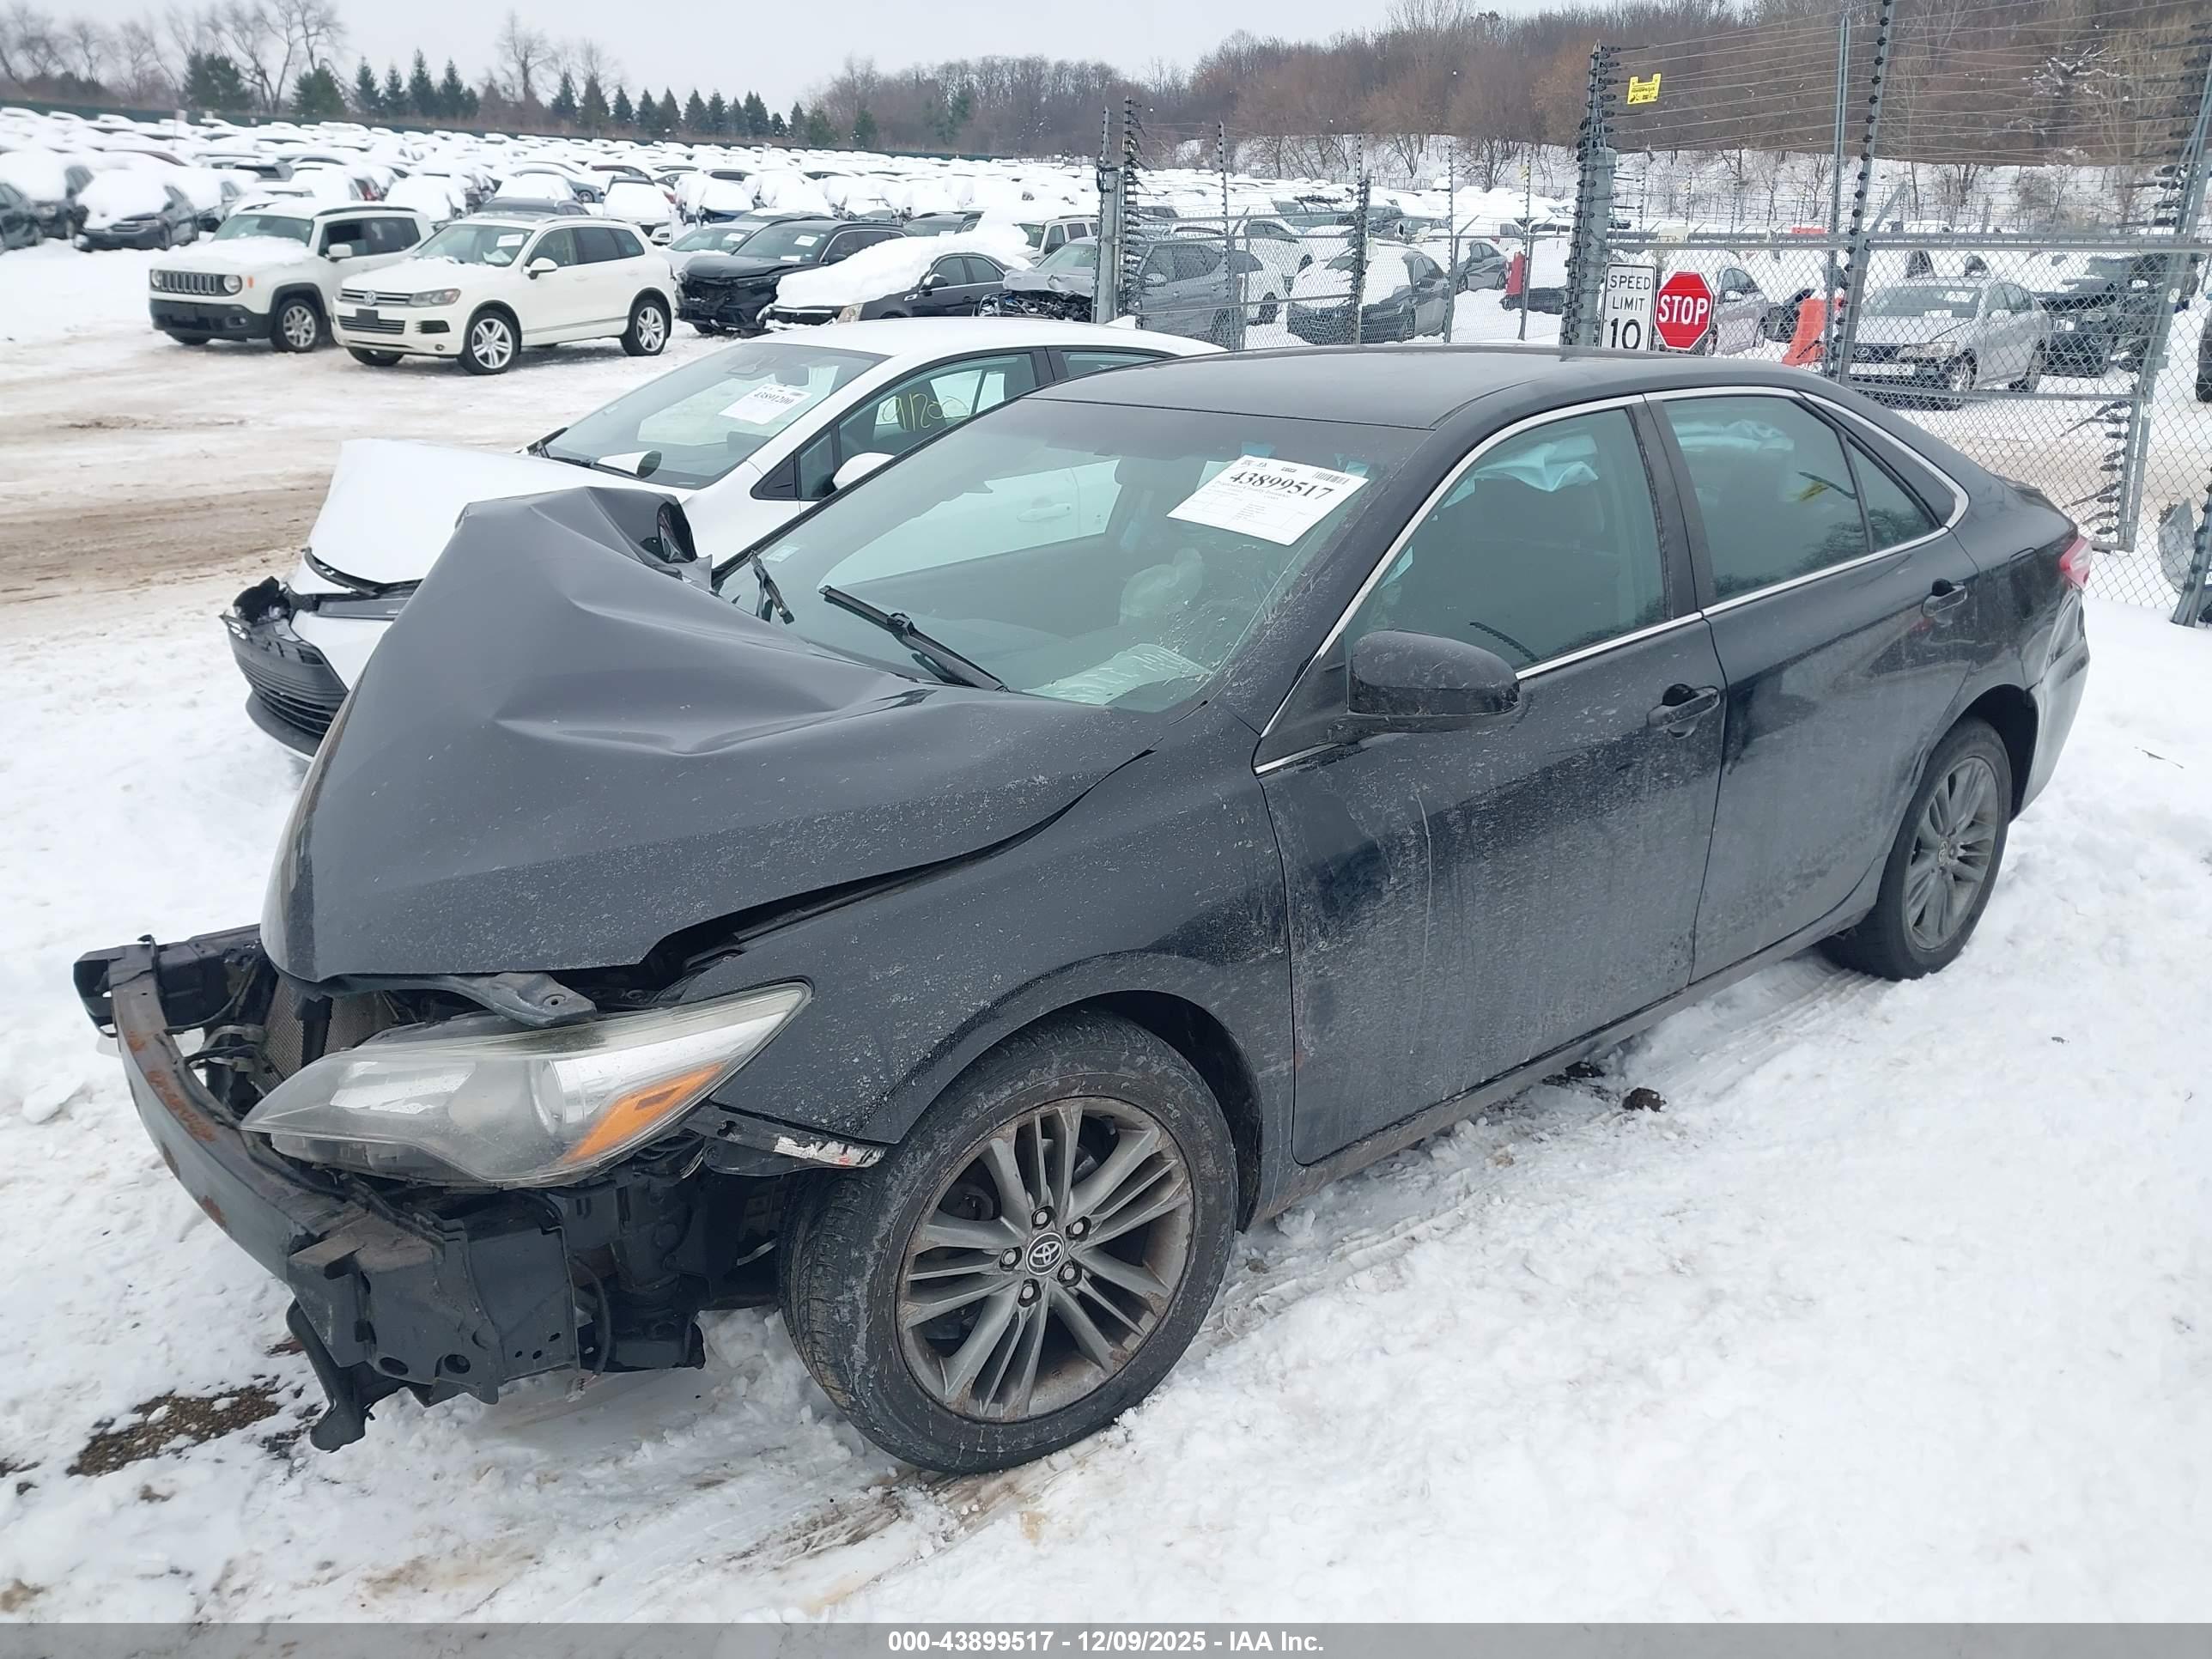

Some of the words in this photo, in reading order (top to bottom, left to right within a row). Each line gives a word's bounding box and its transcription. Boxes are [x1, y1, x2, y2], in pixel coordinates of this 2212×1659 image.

[1609, 275, 1651, 290] SPEED
[1612, 295, 1646, 312] LIMIT
[1658, 294, 1709, 325] STOP
[1610, 318, 1642, 349] 10
[1230, 471, 1335, 500] 43899517
